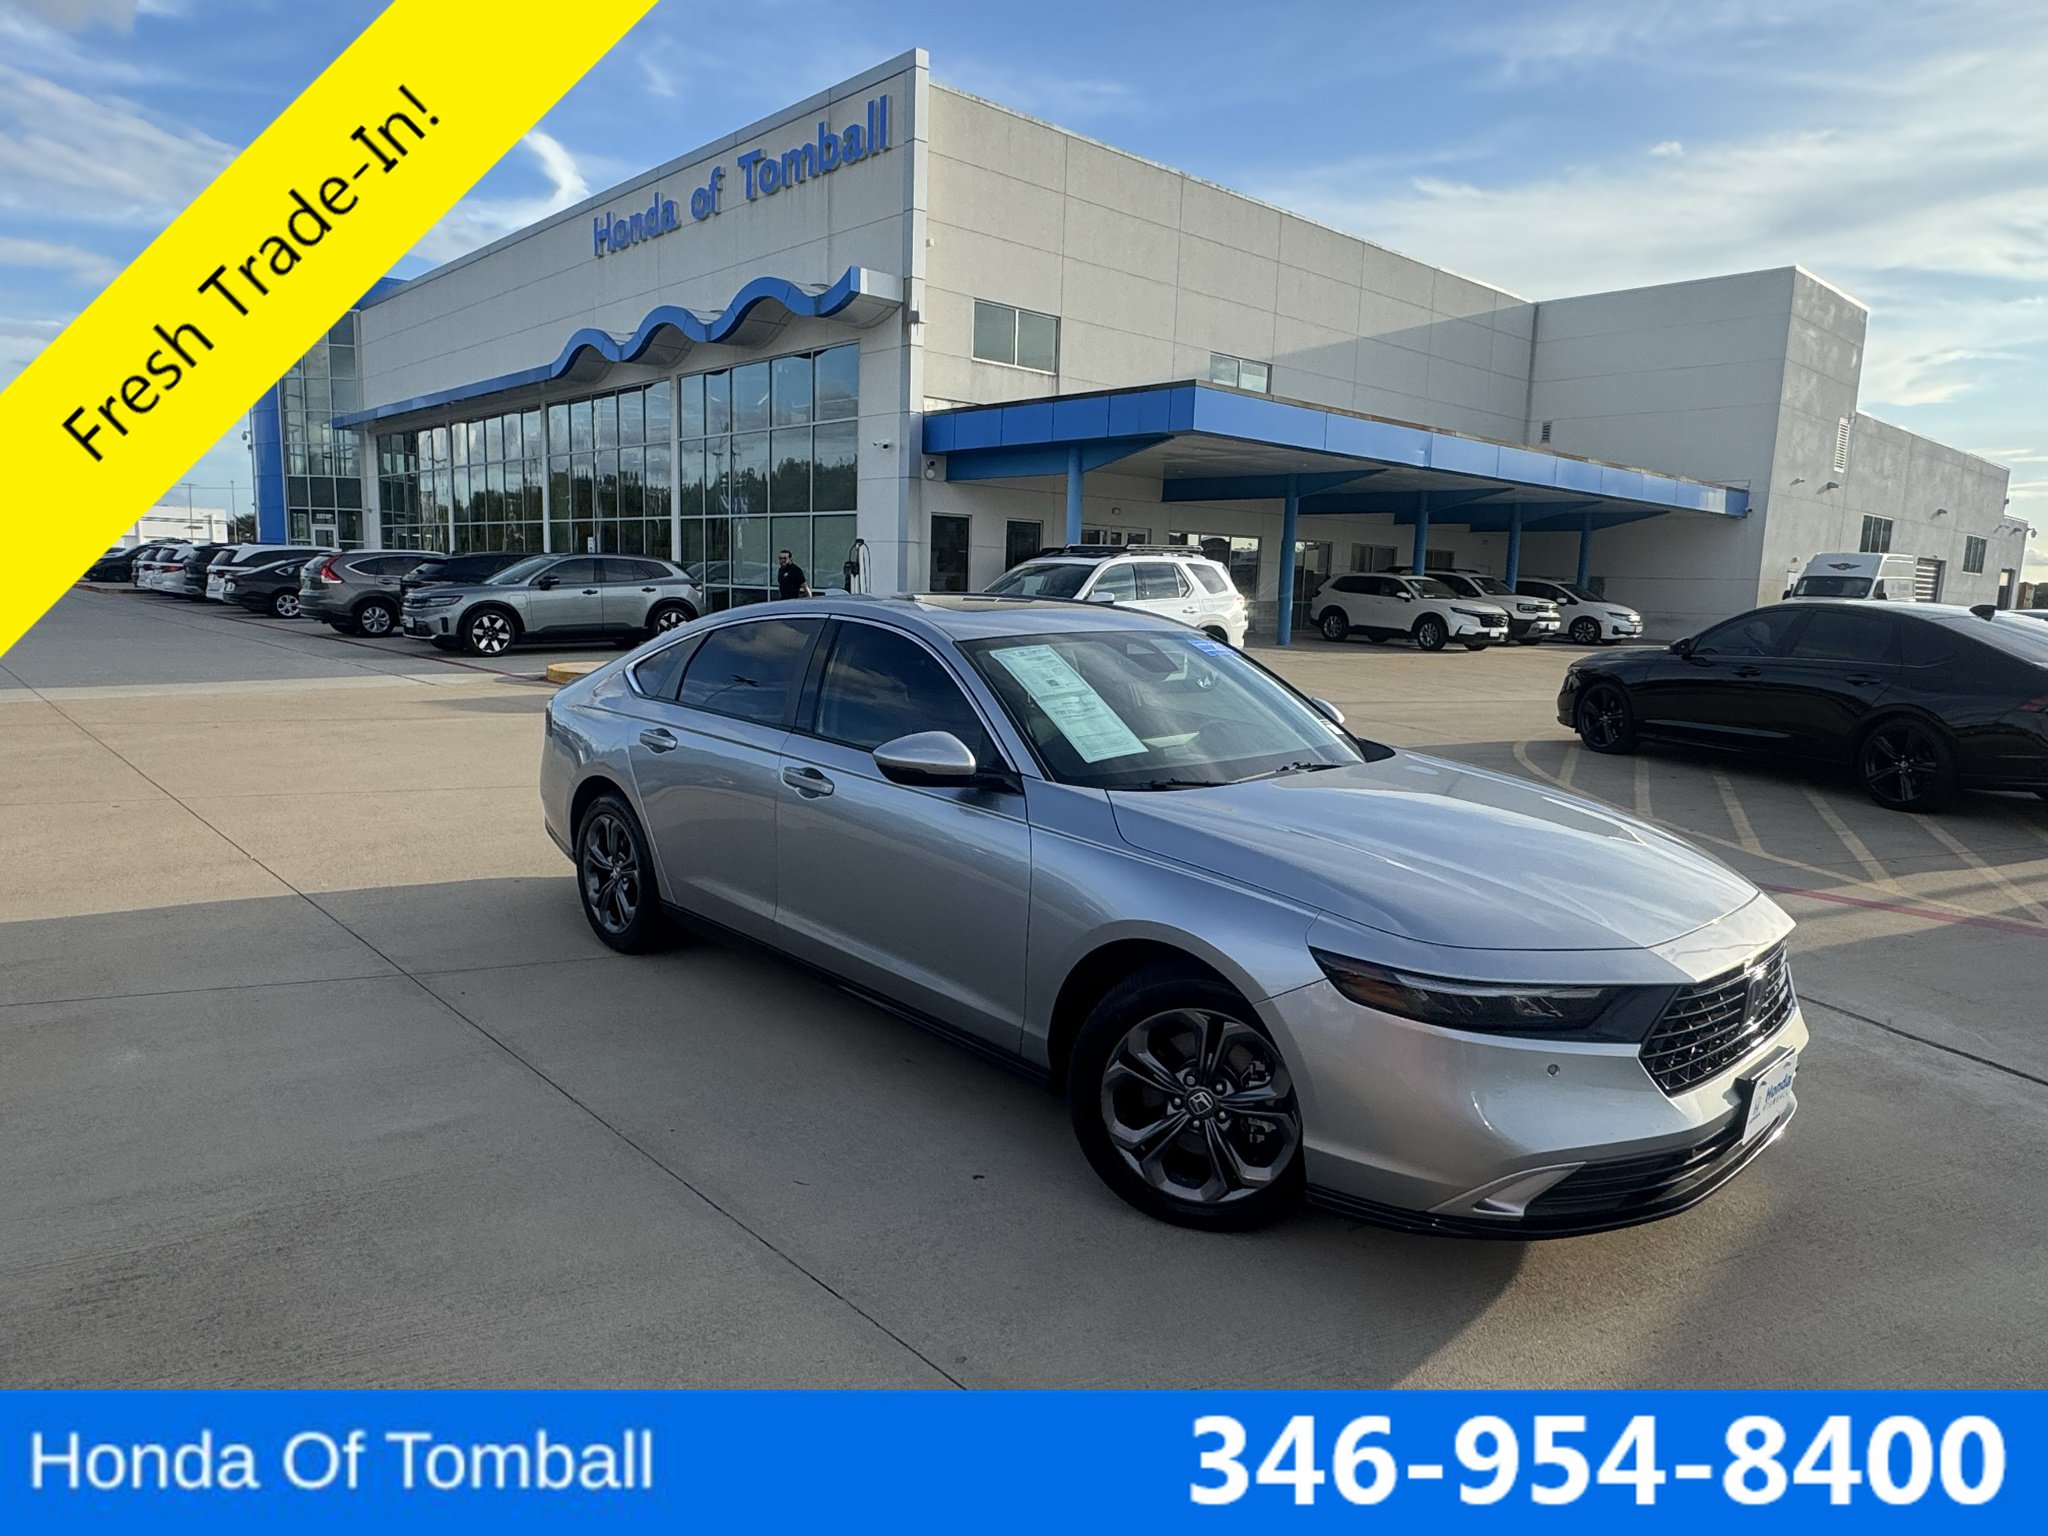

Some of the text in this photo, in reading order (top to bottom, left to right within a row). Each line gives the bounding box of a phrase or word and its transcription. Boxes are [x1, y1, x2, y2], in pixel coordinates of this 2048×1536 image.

[593, 94, 893, 258] Honda of Tomball
[1765, 1074, 1792, 1103] Honda
